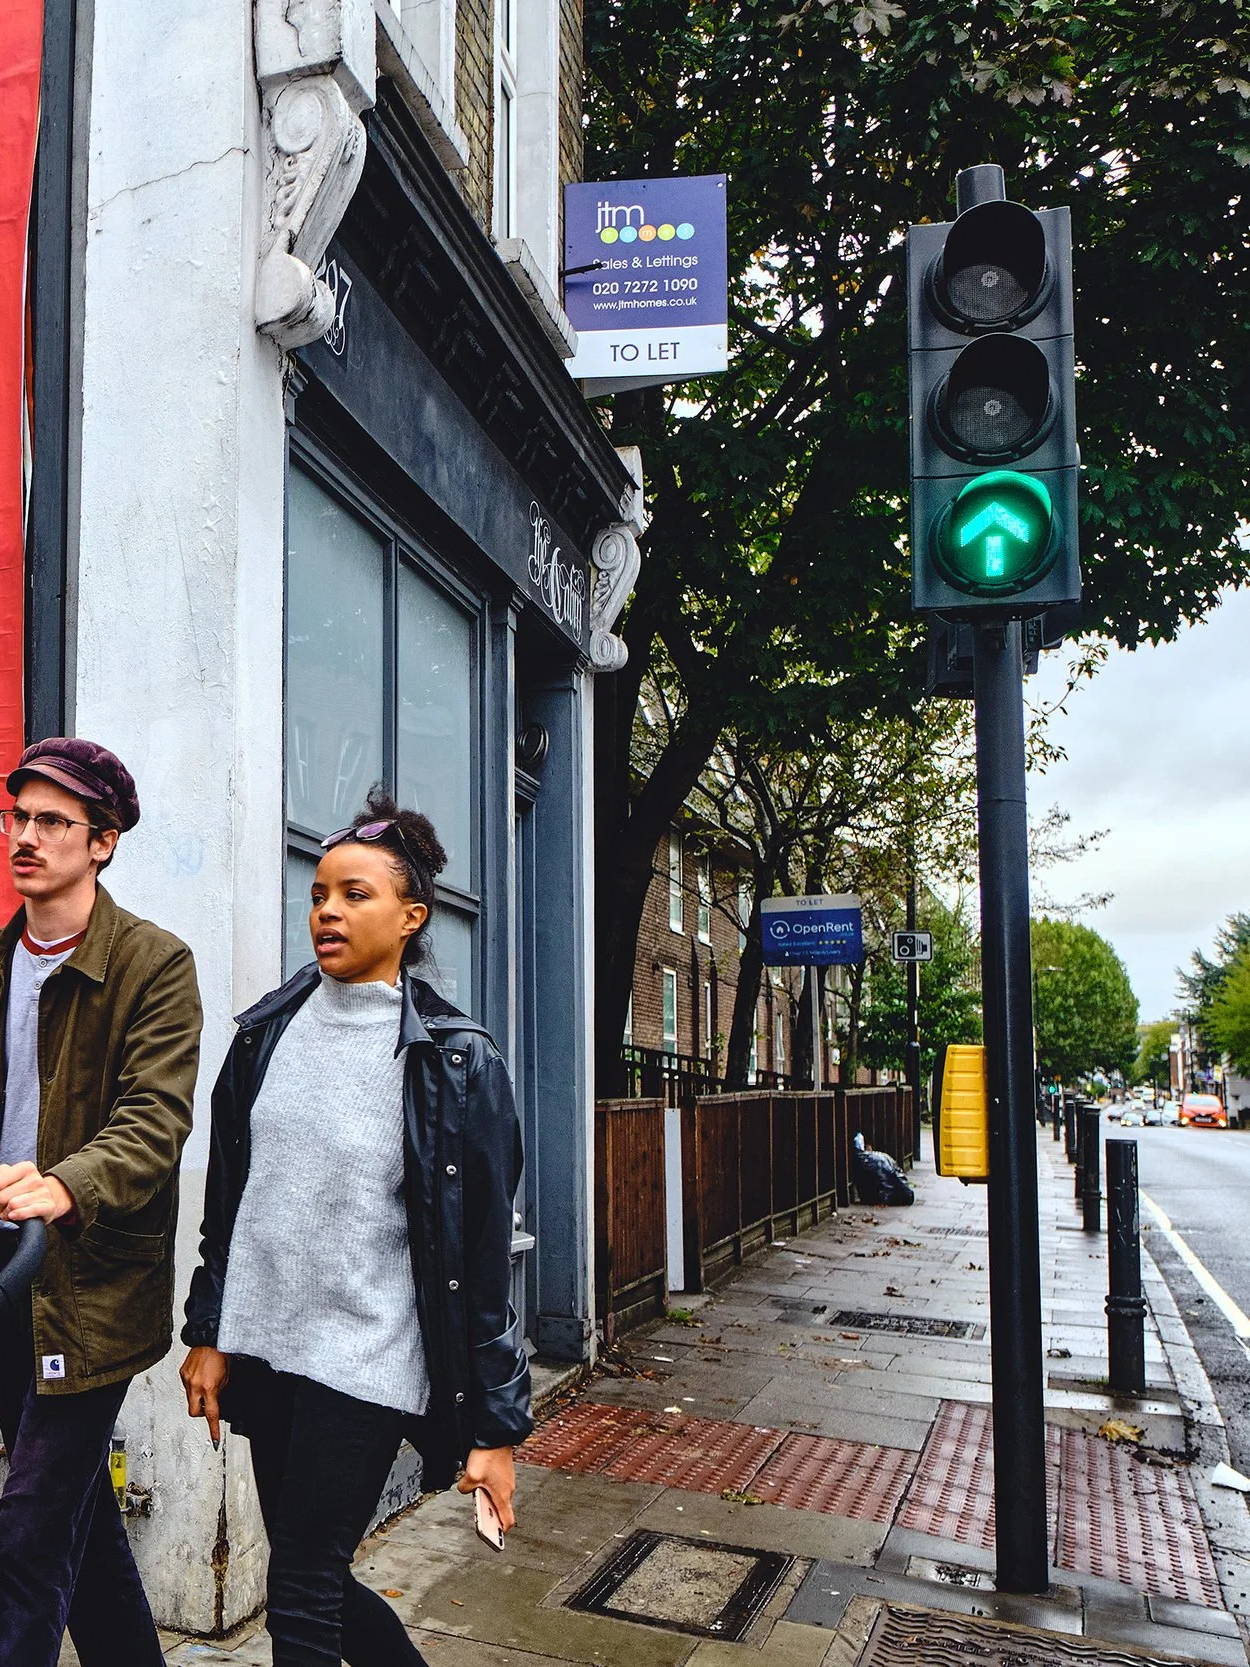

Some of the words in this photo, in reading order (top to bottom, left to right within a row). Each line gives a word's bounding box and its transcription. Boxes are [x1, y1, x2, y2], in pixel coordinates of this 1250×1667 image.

[595, 201, 645, 234] jtm
[632, 257, 643, 269] &
[647, 254, 698, 269] Lettings
[593, 282, 619, 295] 020
[624, 280, 658, 293] 7272
[664, 278, 698, 292] 1090
[593, 296, 697, 311] www.jtmhomes.co.uk
[610, 344, 639, 362] TO
[648, 342, 680, 361] LET
[793, 921, 854, 936] OpenRent
